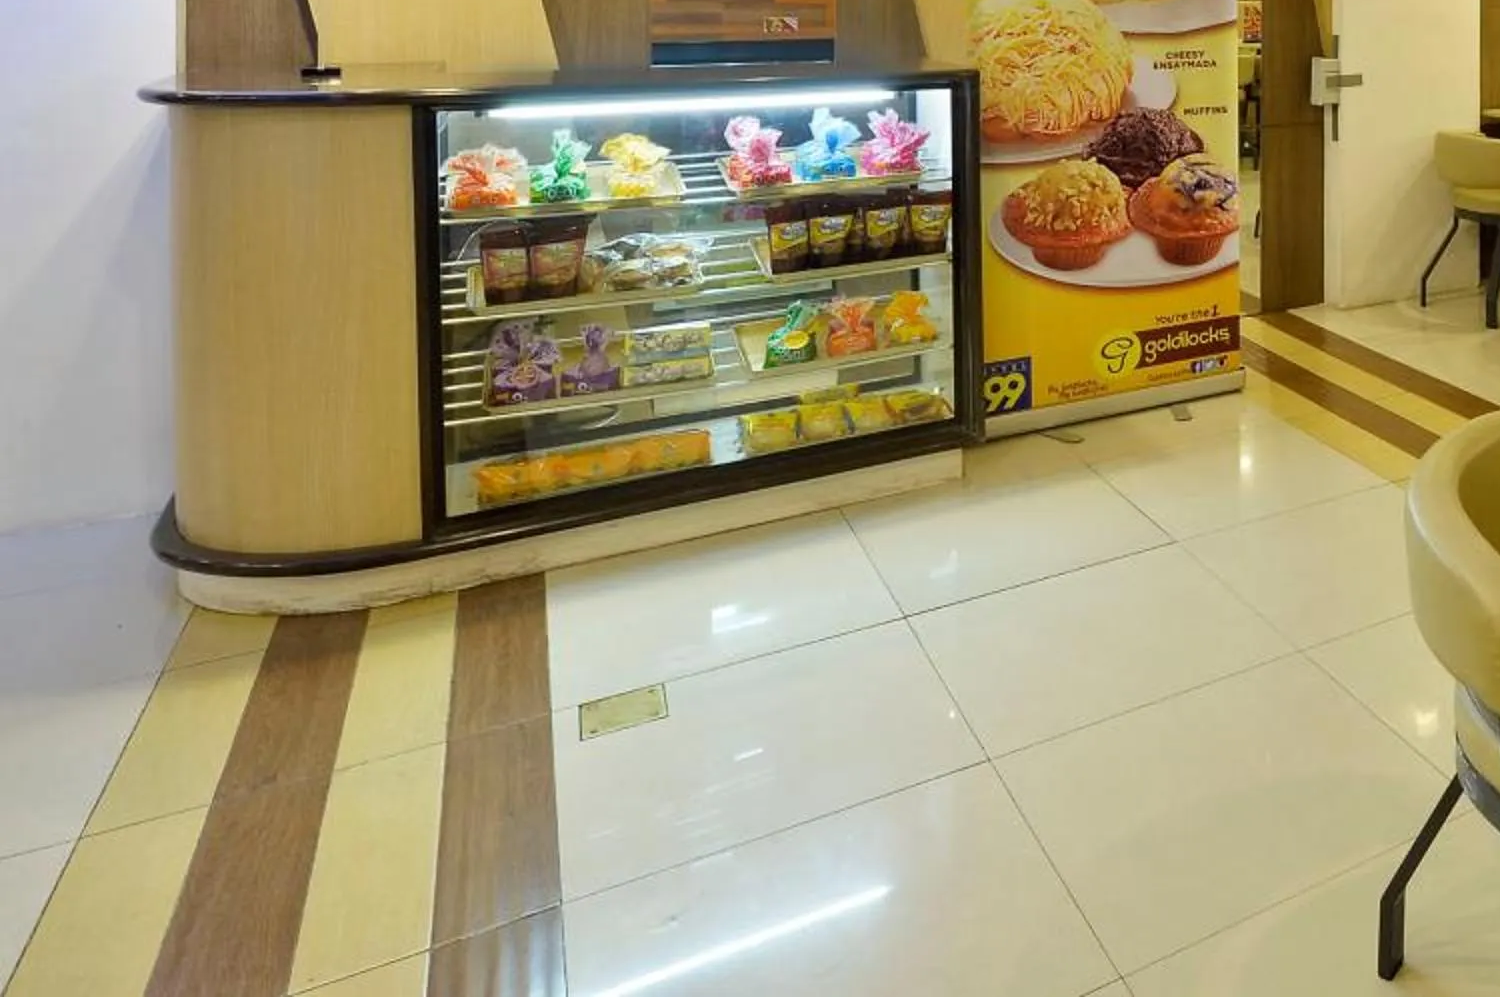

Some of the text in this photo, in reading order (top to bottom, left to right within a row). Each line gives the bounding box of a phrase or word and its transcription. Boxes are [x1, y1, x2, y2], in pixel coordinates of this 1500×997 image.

[1165, 50, 1205, 60] CHEESY
[1183, 106, 1229, 116] MUFFINS
[1144, 326, 1231, 363] goldilocks
[983, 372, 1028, 413] 99
